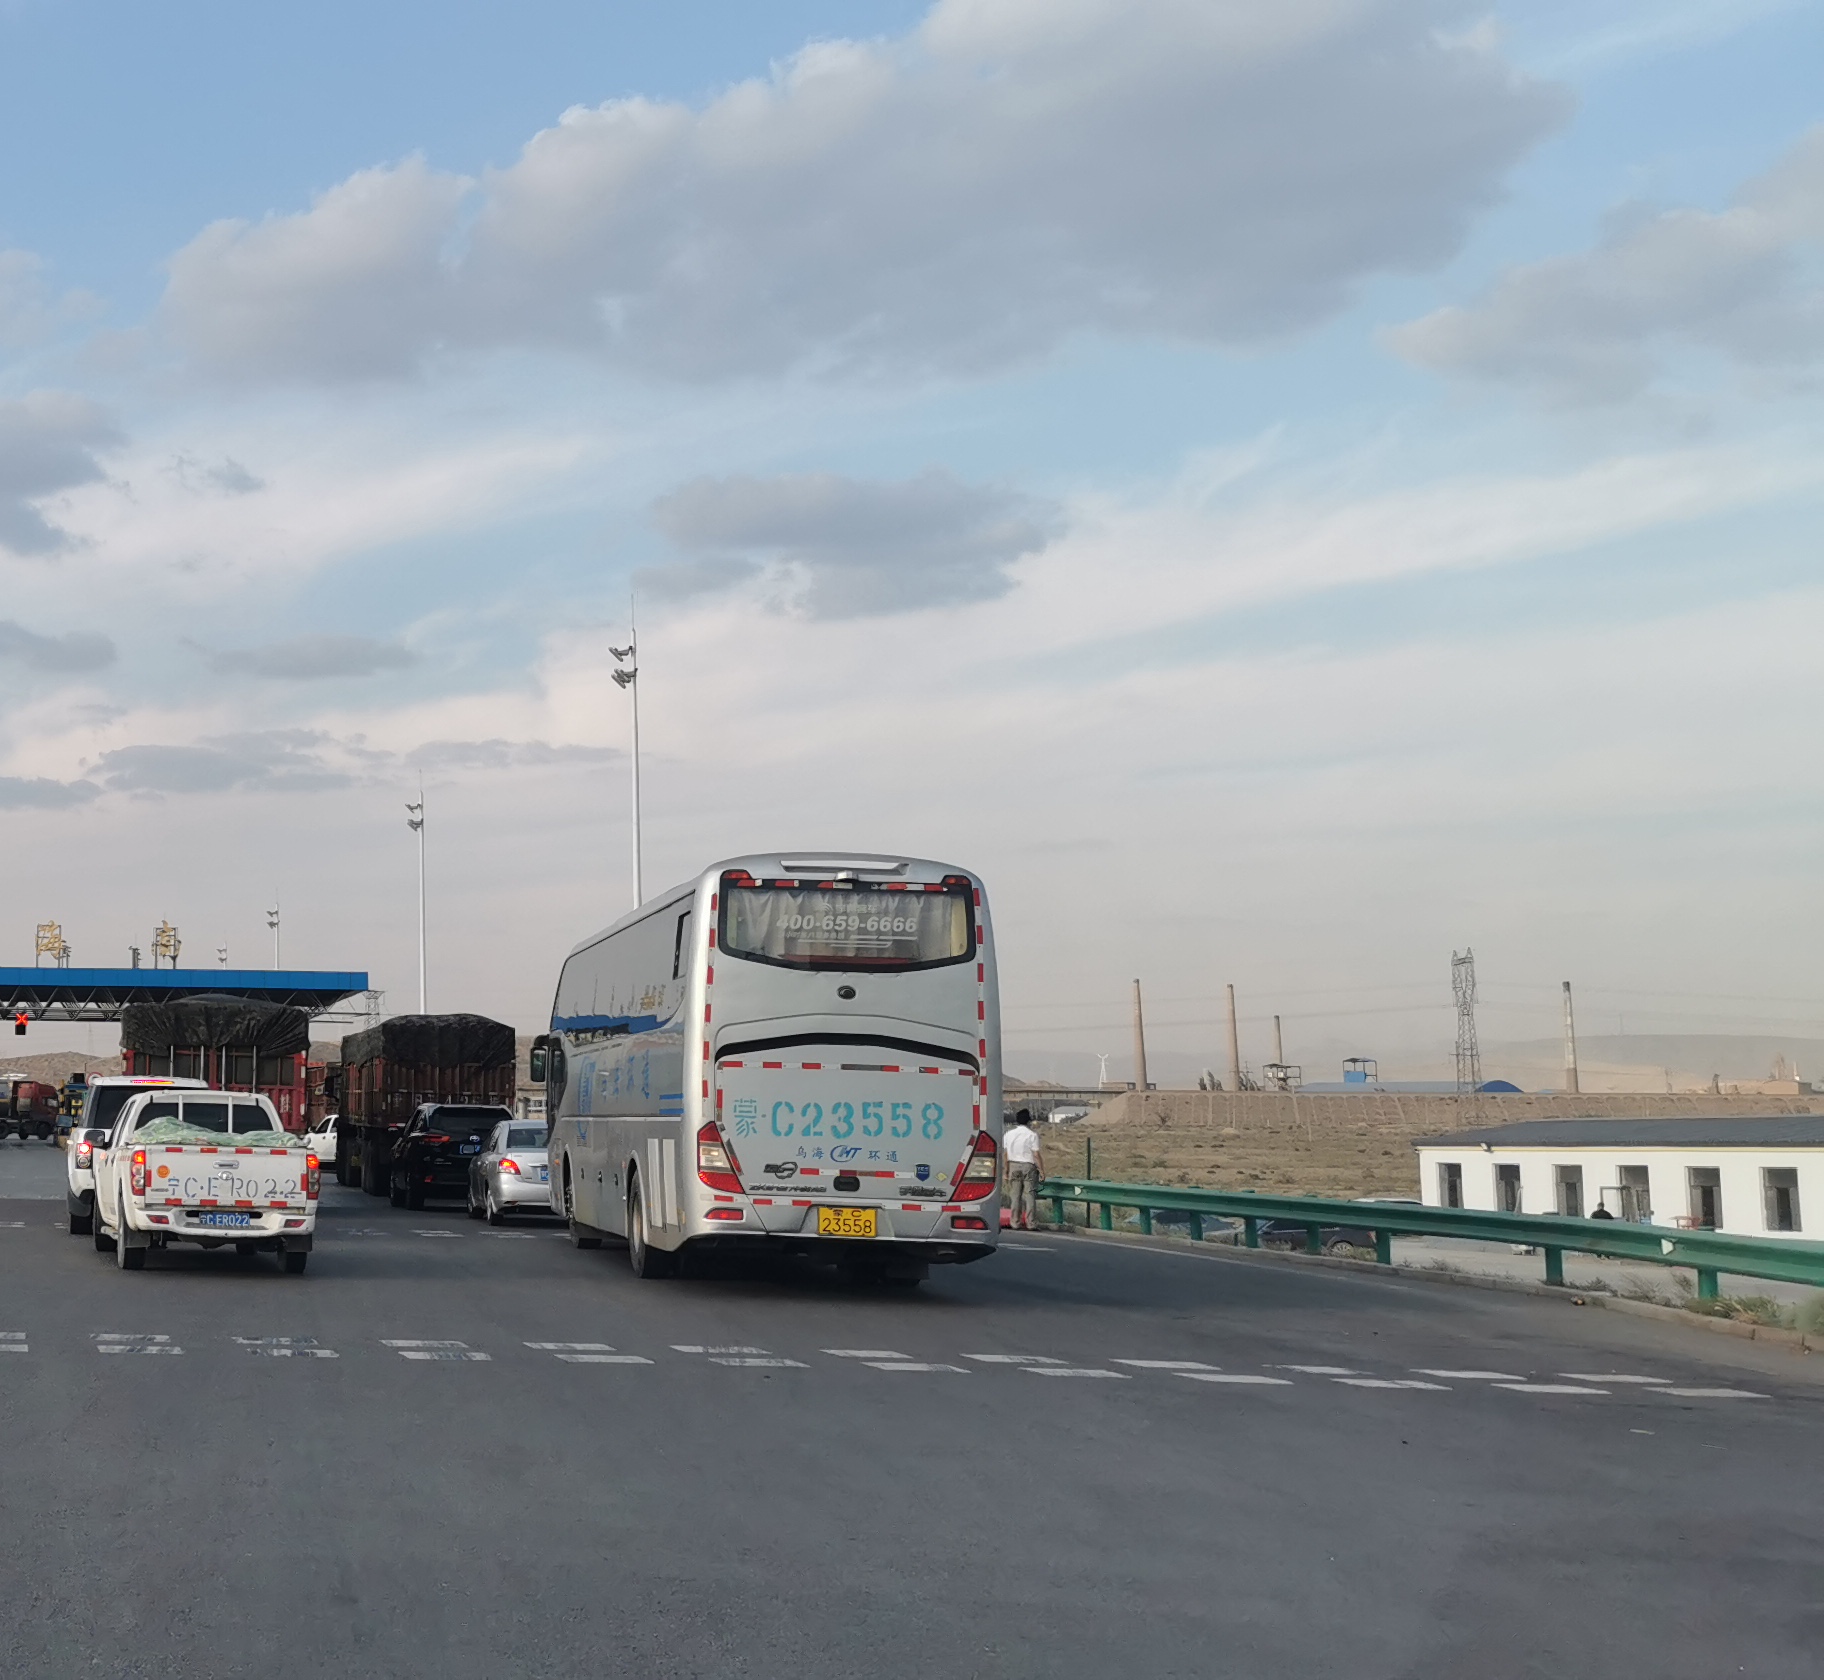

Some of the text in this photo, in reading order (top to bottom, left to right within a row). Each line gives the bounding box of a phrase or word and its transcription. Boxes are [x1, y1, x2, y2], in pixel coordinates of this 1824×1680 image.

[776, 914, 917, 933] 400-659-6666
[796, 1145, 824, 1160] 乌海
[867, 1150, 899, 1162] 环通
[822, 1217, 872, 1234] 23558
